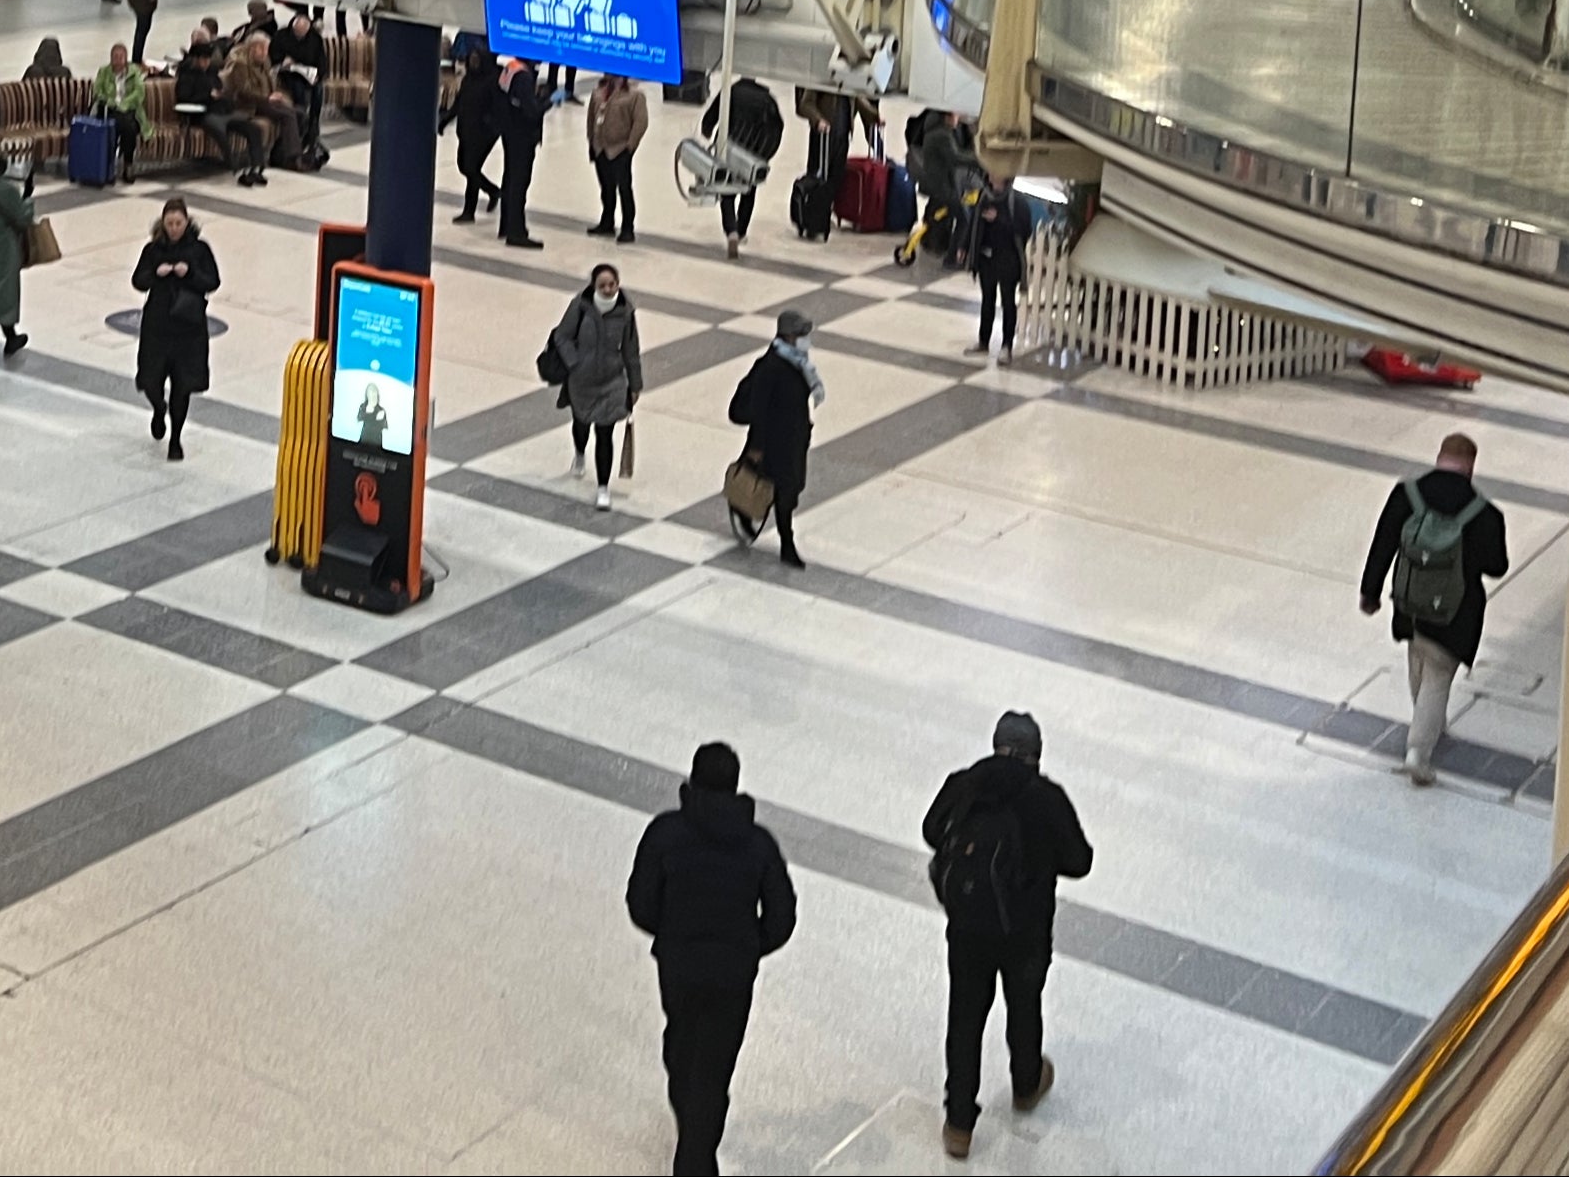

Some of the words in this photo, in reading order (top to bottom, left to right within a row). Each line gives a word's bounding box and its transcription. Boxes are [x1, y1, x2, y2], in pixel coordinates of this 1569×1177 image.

[499, 17, 531, 34] Please
[532, 23, 554, 39] keep
[555, 29, 575, 42] your
[577, 31, 626, 52] belongings
[628, 39, 647, 53] with
[649, 45, 667, 57] you
